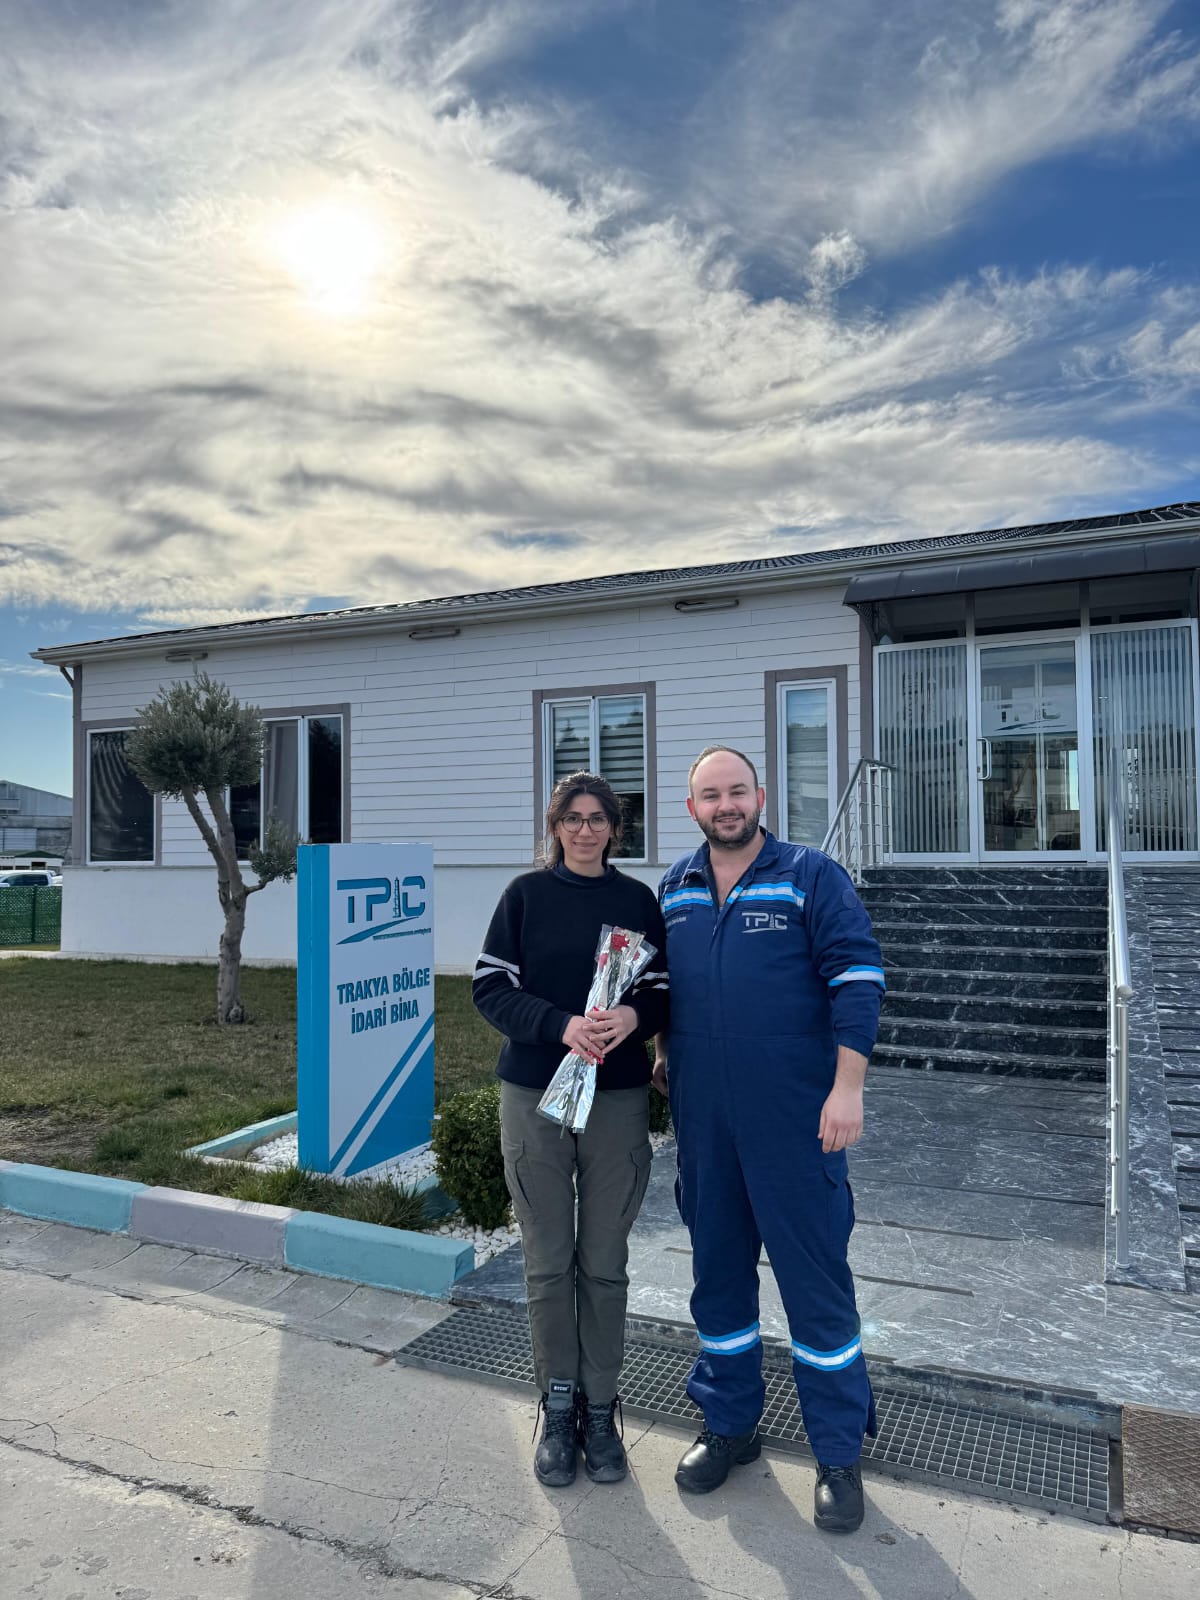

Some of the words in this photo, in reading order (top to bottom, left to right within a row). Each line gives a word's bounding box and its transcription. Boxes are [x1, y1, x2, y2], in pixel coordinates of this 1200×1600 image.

[337, 976, 389, 1004] TRAKYA
[393, 968, 430, 992] BÖLGE
[352, 1001, 386, 1034] İDARİ
[391, 997, 419, 1024] BİNA
